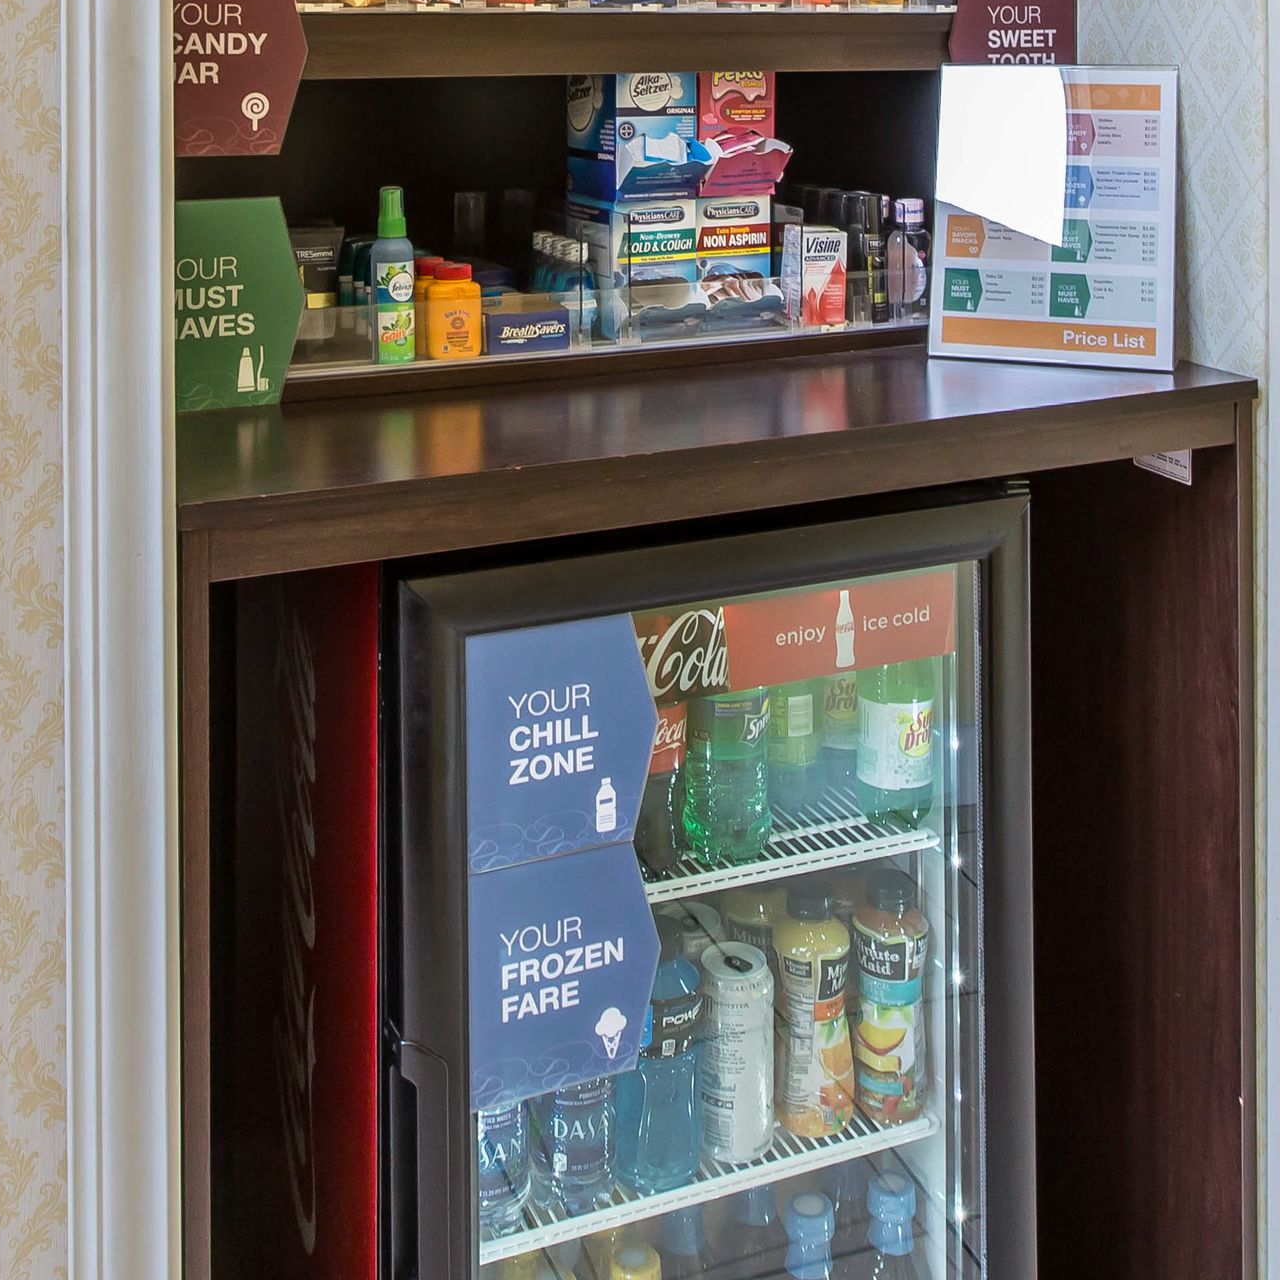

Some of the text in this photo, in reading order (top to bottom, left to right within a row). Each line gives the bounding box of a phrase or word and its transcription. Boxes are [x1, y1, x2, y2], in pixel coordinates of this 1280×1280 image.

[988, 5, 1041, 24] YOUR
[988, 29, 1056, 48] SWEET
[633, 83, 670, 97] Seltzer
[635, 74, 663, 87] Alka-
[652, 239, 692, 252] & COUGH
[703, 232, 767, 248] NON ASPIRIN
[806, 237, 841, 253] Visine
[381, 329, 405, 343] Gain
[1062, 329, 1146, 348] Price List
[775, 605, 930, 646] enjoy ice cold
[508, 683, 591, 719] YOUR
[508, 715, 599, 752] CHILL
[508, 745, 594, 786] ZONE
[500, 916, 582, 956] YOUR
[501, 937, 624, 991] FROZEN
[502, 980, 580, 1023] FARE
